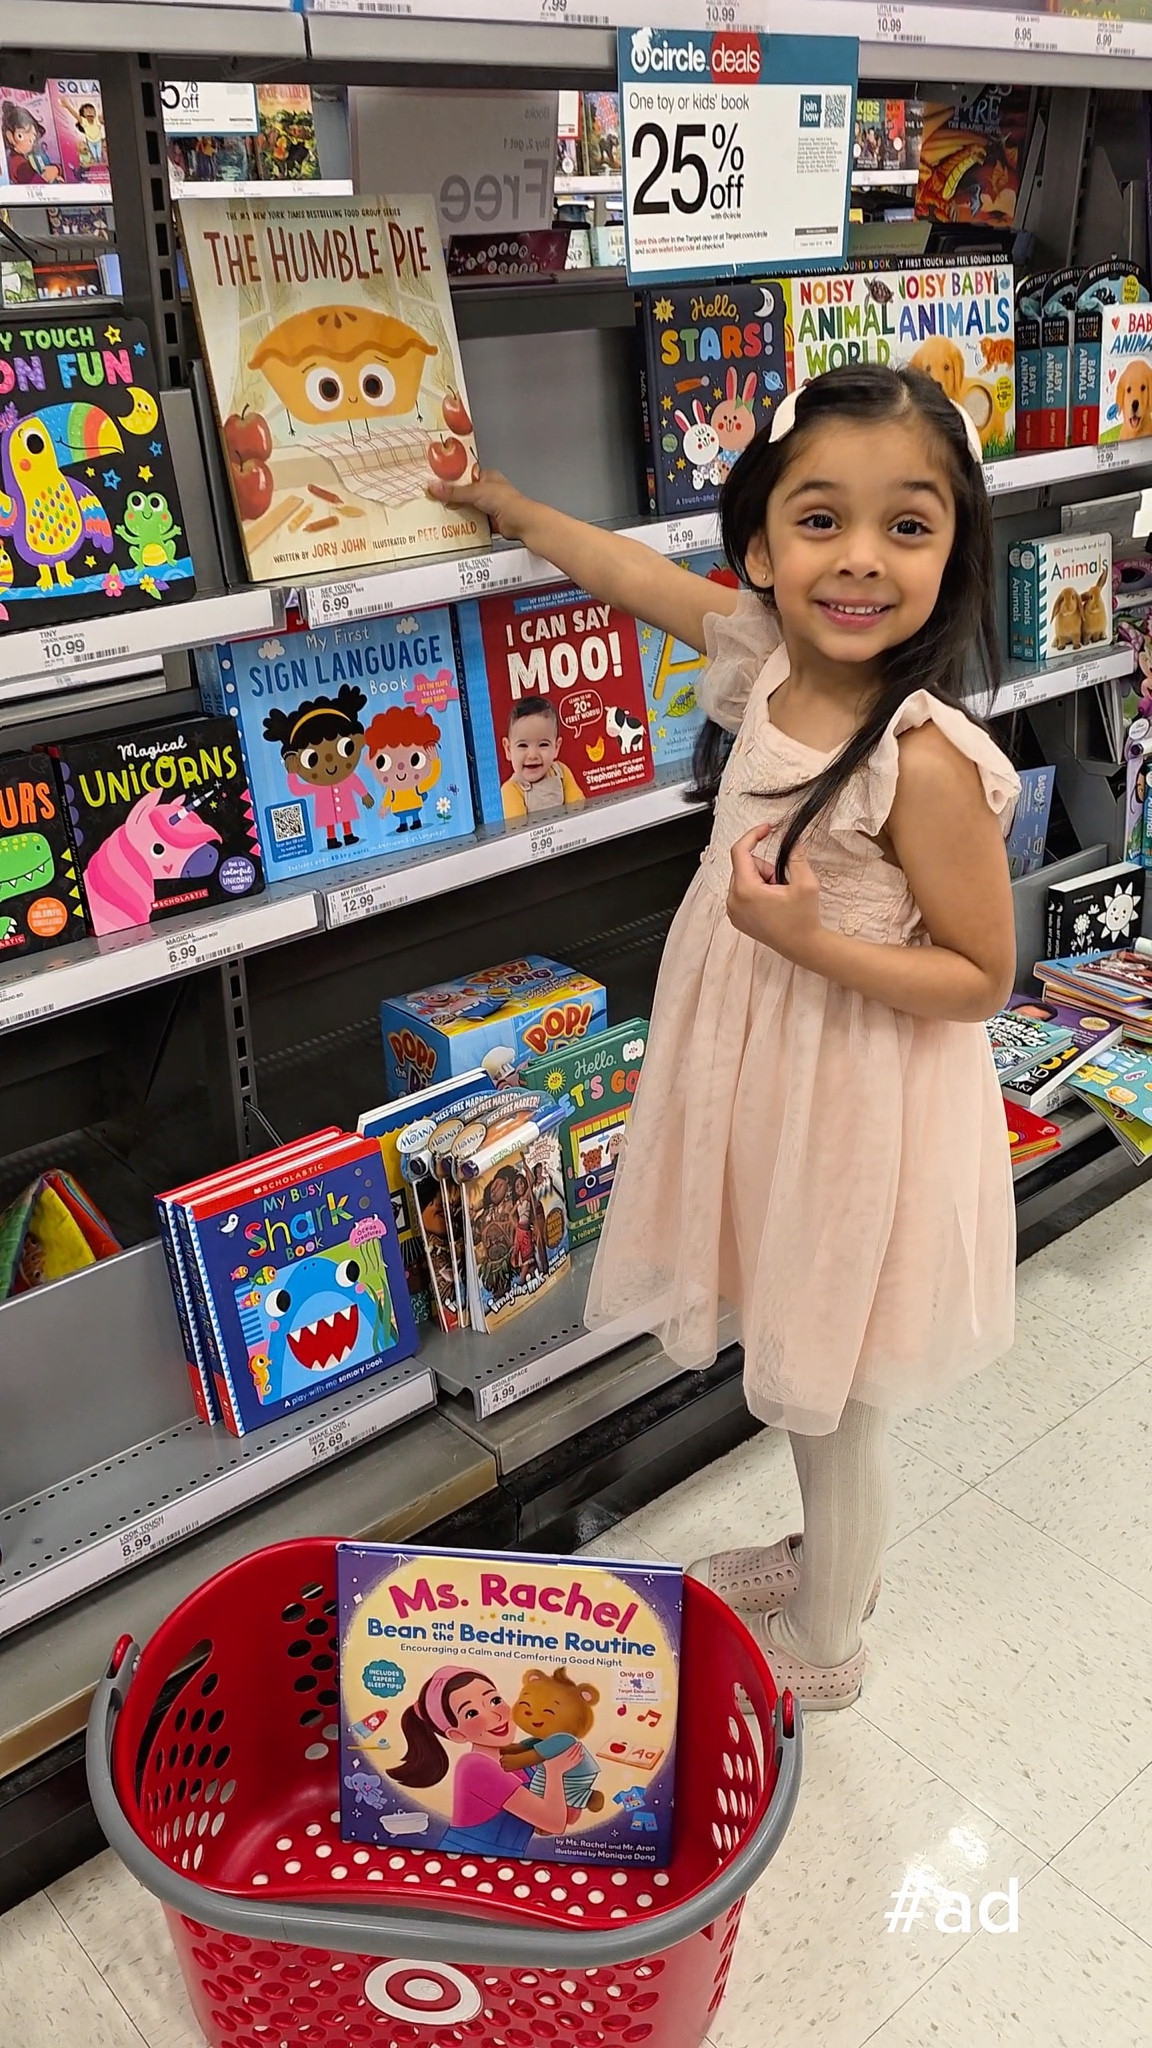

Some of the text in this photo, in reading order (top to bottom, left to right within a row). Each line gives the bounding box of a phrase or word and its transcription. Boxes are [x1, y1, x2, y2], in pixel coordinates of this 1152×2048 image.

[706, 7, 735, 22] 10.99
[877, 18, 902, 32] 10.99
[1014, 28, 1032, 41] 6.95
[1096, 33, 1112, 46] 6.99
[711, 43, 761, 73] deals
[181, 93, 200, 109] off
[629, 92, 750, 114] One toy or kids' book
[803, 100, 818, 112] join
[857, 101, 880, 114] KIDS
[803, 112, 820, 123] now
[710, 174, 744, 209] off
[226, 211, 236, 221] THE
[253, 211, 266, 220] NEW
[268, 210, 285, 219] YORK
[287, 209, 305, 219] TIMES
[306, 208, 342, 218] BESTSELLING
[344, 207, 360, 218] FOOD
[361, 207, 381, 217] GROUP
[383, 206, 401, 217] SERIES
[203, 221, 431, 287] THE HUMBLE PIE
[465, 242, 529, 270] TAYLOR
[905, 253, 1009, 268] FIRST TOUCH AND FEEL SOUND BOOK
[800, 279, 855, 306] NOISY
[952, 270, 994, 297] BABY
[690, 294, 740, 323] Hello,
[798, 303, 896, 343] ANIMAL
[899, 297, 1010, 343] ANIMALS
[20, 326, 95, 351] TOUCH
[660, 321, 773, 366] STARS!
[57, 349, 134, 389] FUN
[1046, 352, 1055, 404] ANIMALS
[1054, 363, 1062, 392] BABY
[1078, 348, 1088, 401] ANIMALS
[1087, 359, 1096, 389] BABY
[273, 520, 478, 564] WRITTEN BY JORY JOHN ILLUSTRATED BY PETE OSWALD
[668, 530, 693, 544] 14.99
[1062, 547, 1074, 555] baby
[459, 569, 490, 586] 12.99
[1050, 552, 1109, 582] Animals
[322, 596, 350, 613] 6.99
[1023, 579, 1034, 626] Animals
[39, 630, 57, 639] TINY
[506, 624, 514, 647] I
[520, 614, 567, 643] CAN
[572, 604, 611, 633] SAY
[43, 639, 85, 659] 10.99
[305, 626, 370, 652] My First
[249, 635, 443, 698] SIGN LANGUAGE
[506, 631, 623, 700] MOO!
[369, 675, 408, 695] Book
[1076, 672, 1089, 682] 7.99
[1013, 690, 1027, 702] 7.99
[573, 701, 592, 715] 20+
[117, 735, 188, 762] Magical
[586, 763, 644, 785] Stephanie Cohen
[531, 836, 553, 852] 9.99
[222, 866, 252, 877] colorful
[343, 894, 374, 913] 12.99
[165, 932, 196, 946] MAGICAL
[169, 945, 197, 963] 6.99
[467, 960, 531, 985] POP!
[523, 1002, 593, 1055] POP!
[388, 1028, 437, 1079] POP!
[400, 1125, 436, 1148] MOANA
[262, 1163, 324, 1192] SCHOLASTIC
[263, 1195, 286, 1214] My
[244, 1192, 354, 1258] Shark
[357, 1224, 377, 1237] Ocean
[354, 1229, 382, 1245] Creatures
[285, 1236, 325, 1261] Book
[487, 1268, 546, 1314] imagine ink
[284, 1357, 384, 1409] A play-with-me sensory book
[492, 1385, 515, 1404] 4.99
[311, 1432, 343, 1456] 12.69
[122, 1534, 152, 1557] 8.99
[388, 1573, 639, 1635] Ms. Rachel
[501, 1612, 525, 1623] and
[367, 1617, 656, 1657] Bean and Bedtime Routine
[433, 1631, 454, 1642] the
[400, 1643, 459, 1656] Encouraging
[468, 1647, 493, 1657] Calm
[493, 1650, 512, 1659] and
[513, 1651, 567, 1665] Comforting
[569, 1656, 595, 1666] Good
[596, 1657, 623, 1668] Night
[368, 1669, 400, 1677] INCLUDES
[372, 1675, 396, 1683] EXPERT
[619, 1671, 637, 1679] Only
[554, 1847, 656, 1862] illustrated by Monique Dong
[555, 1838, 565, 1846] by
[565, 1838, 579, 1846] Ms.
[580, 1839, 607, 1849] Rachel
[622, 1843, 635, 1851] Mr.
[635, 1844, 656, 1852] Aron
